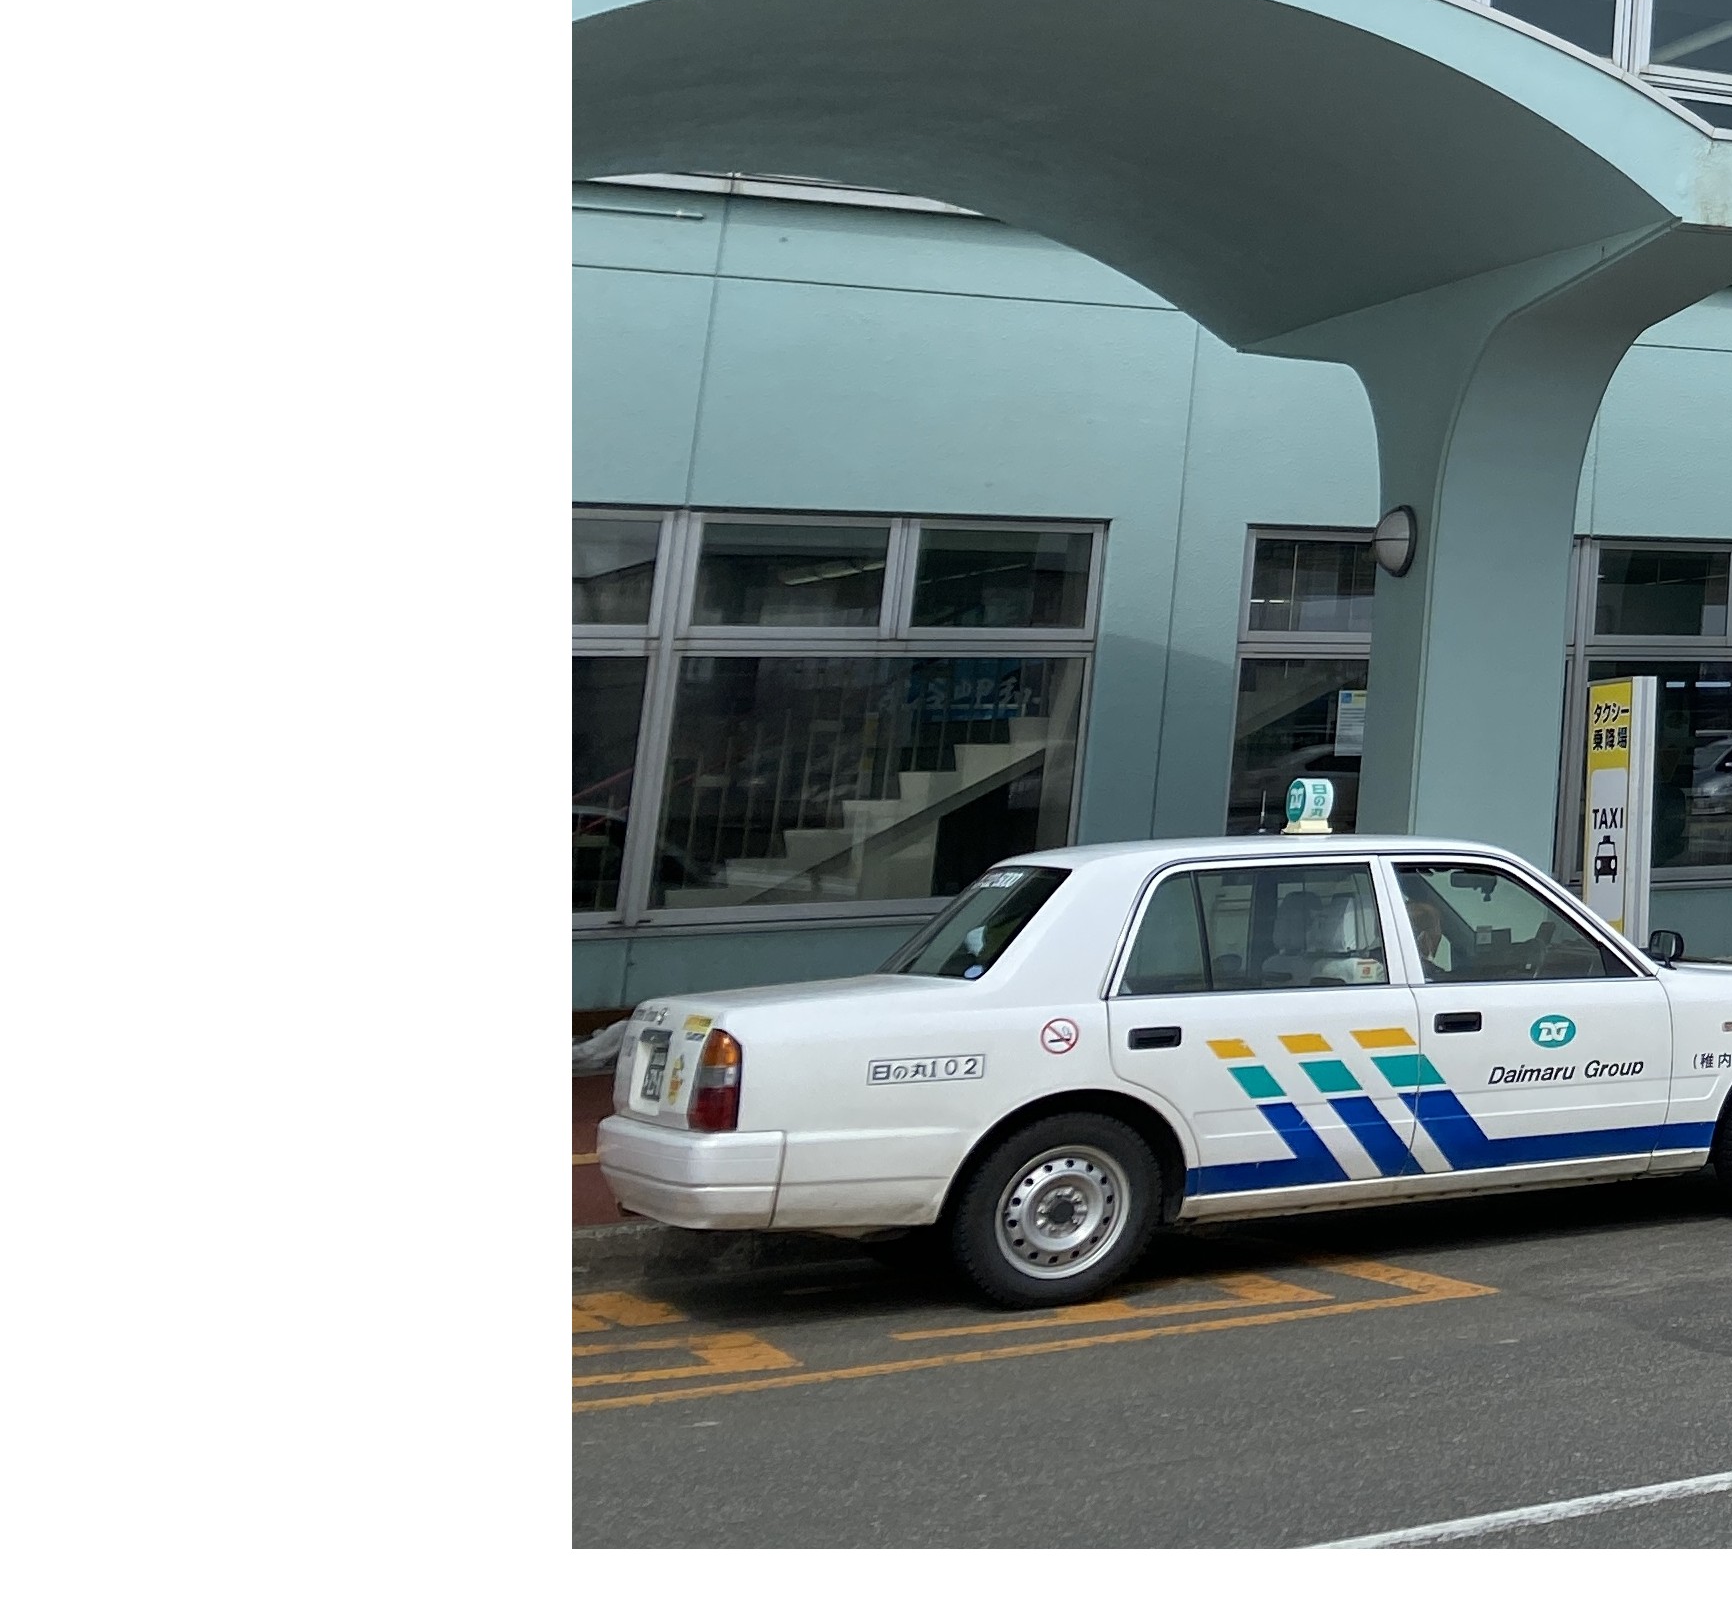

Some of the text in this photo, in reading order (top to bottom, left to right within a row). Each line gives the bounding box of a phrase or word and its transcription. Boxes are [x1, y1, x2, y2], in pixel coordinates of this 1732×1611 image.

[1593, 702, 1630, 725] タクシー
[1592, 726, 1628, 751] 乗降場
[1311, 783, 1327, 818] 日の丸
[1592, 806, 1624, 830] TAXI
[1488, 1059, 1645, 1085] Daimaru Group
